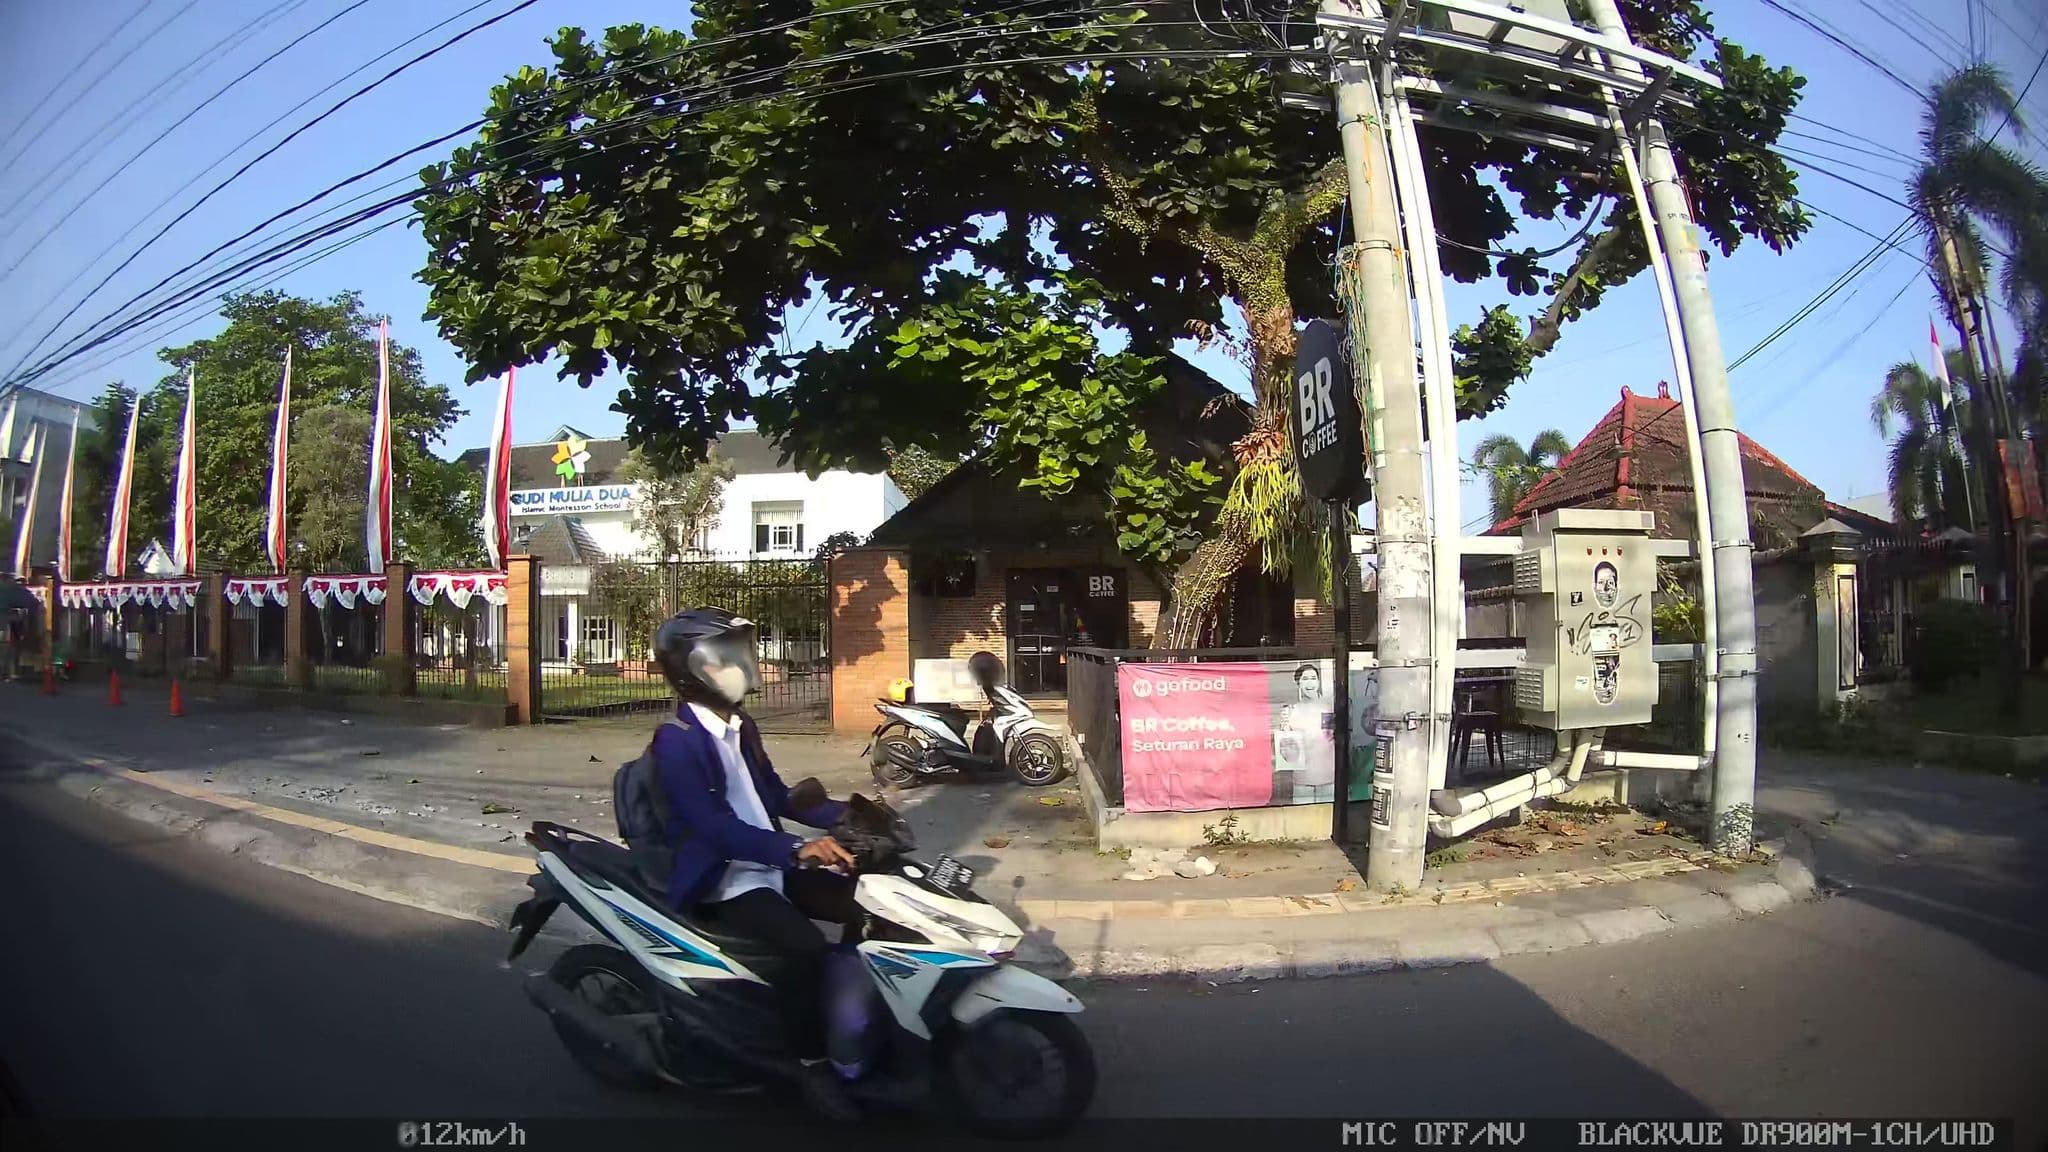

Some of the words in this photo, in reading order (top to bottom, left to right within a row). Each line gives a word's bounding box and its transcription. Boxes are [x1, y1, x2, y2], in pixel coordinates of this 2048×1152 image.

[1299, 357, 1335, 436] BR
[1302, 420, 1338, 459] COFFEE
[510, 492, 545, 505] BUDI
[549, 489, 594, 503] MULIA
[599, 487, 631, 501] DUA
[594, 502, 621, 510] School
[1089, 576, 1115, 591] BR
[1156, 676, 1226, 696] gofood
[1130, 717, 1157, 732] BR
[1162, 716, 1235, 732] Coffee,
[1132, 739, 1200, 752] Seturan
[1203, 737, 1244, 752] Raya
